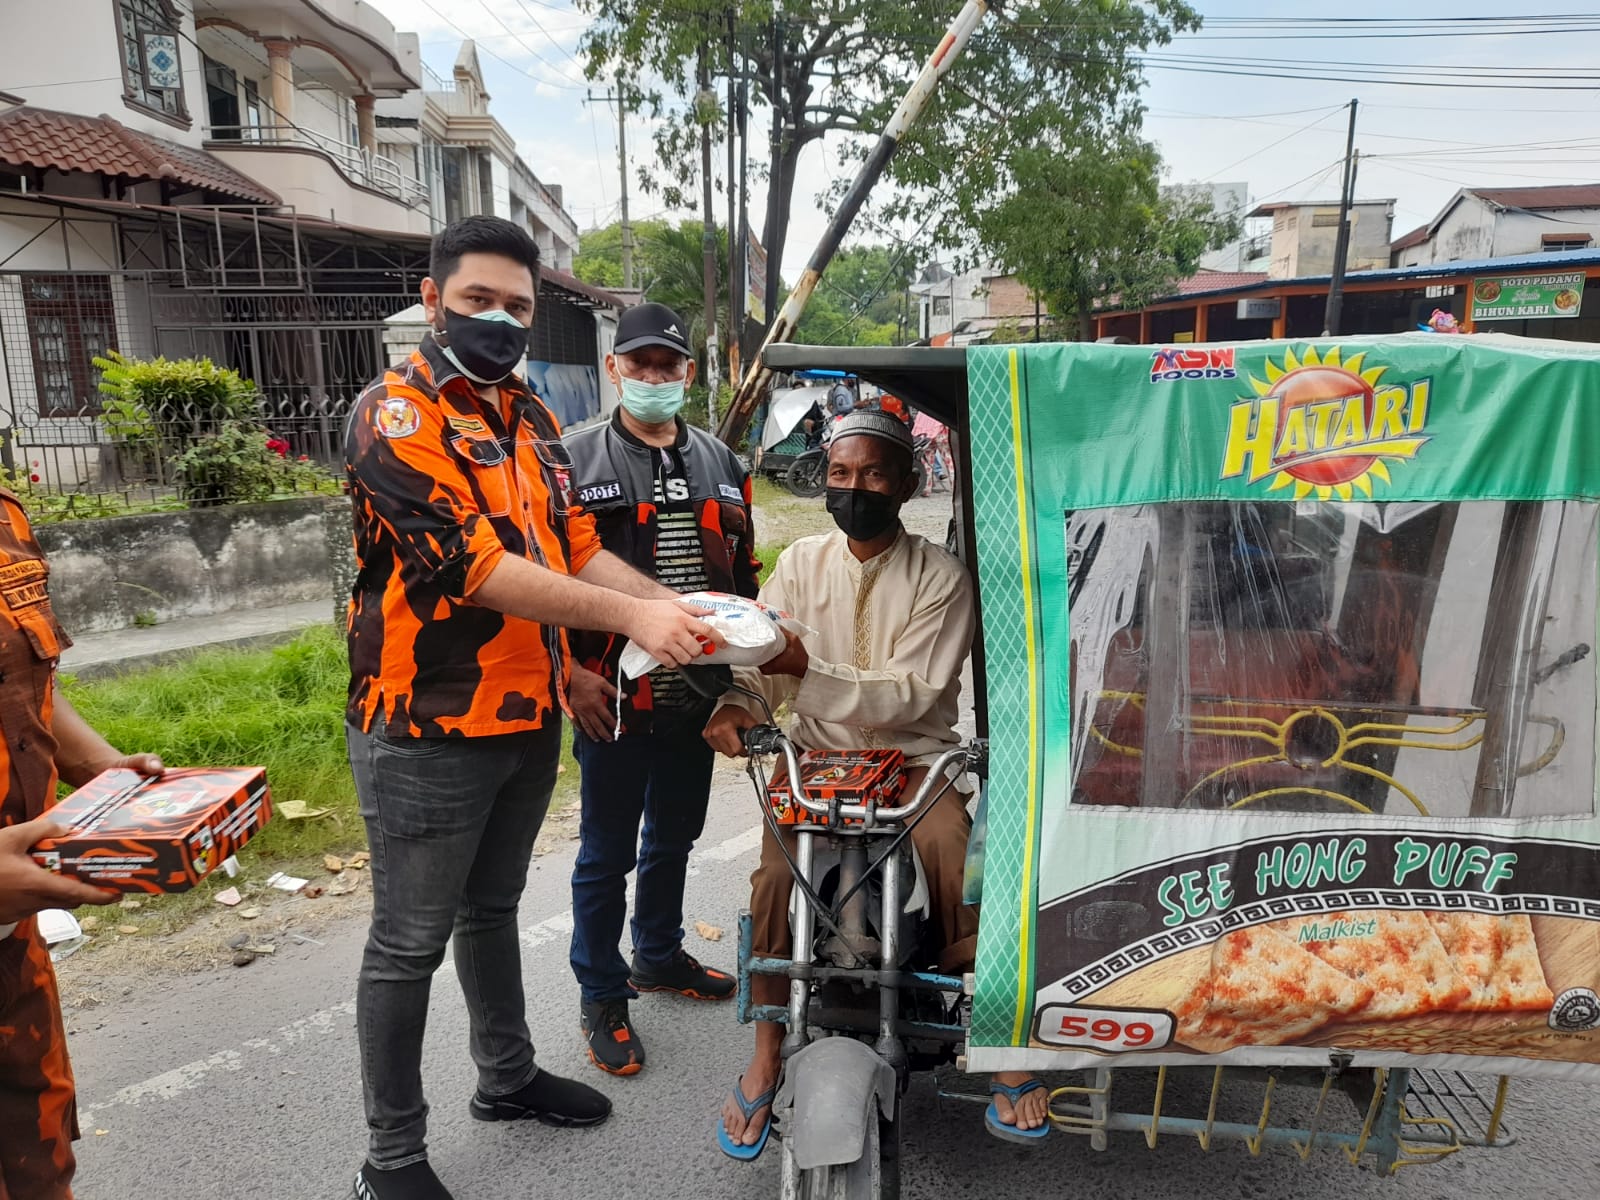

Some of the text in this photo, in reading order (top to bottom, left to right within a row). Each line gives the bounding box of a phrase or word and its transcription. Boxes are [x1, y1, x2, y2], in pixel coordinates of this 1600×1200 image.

[1502, 275, 1581, 287] SOTO PADANG
[1475, 305, 1549, 317] BIHUN KARI
[1151, 368, 1237, 383] FOODS
[1220, 376, 1432, 486] HATARI
[1157, 837, 1519, 927] SEE HONG PUFF
[1298, 918, 1378, 945] Malkist
[1056, 1014, 1156, 1047] 599
